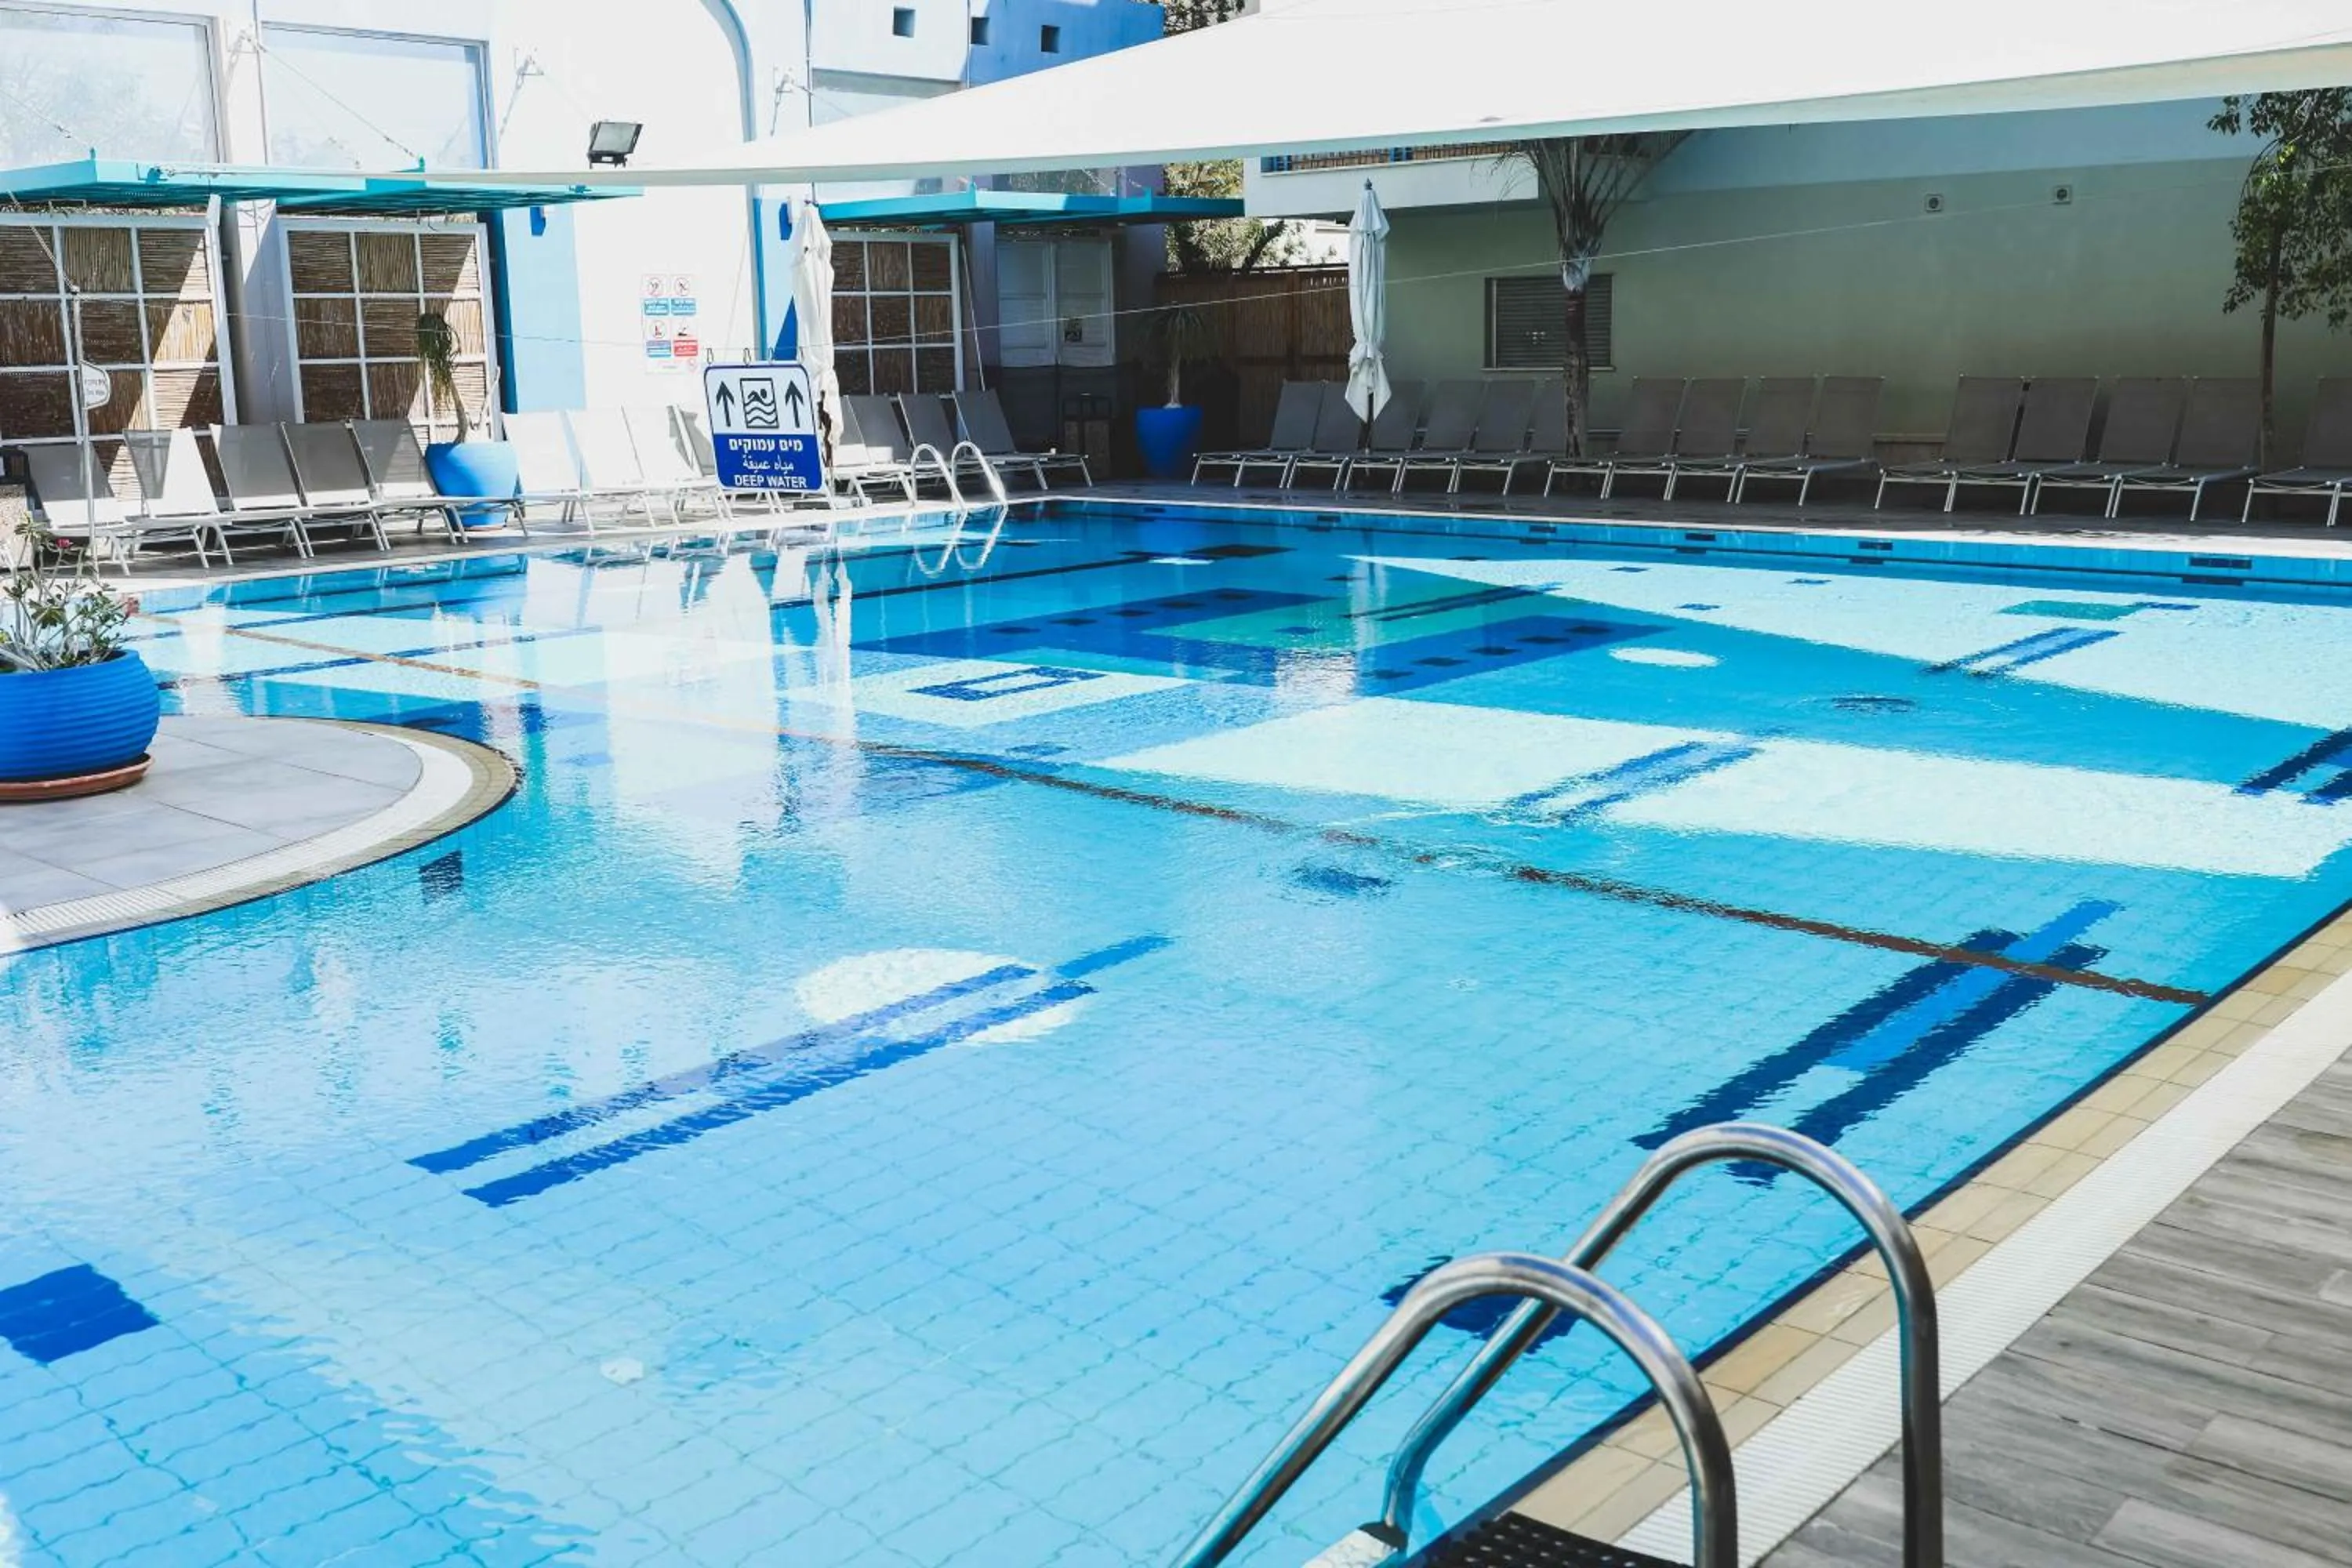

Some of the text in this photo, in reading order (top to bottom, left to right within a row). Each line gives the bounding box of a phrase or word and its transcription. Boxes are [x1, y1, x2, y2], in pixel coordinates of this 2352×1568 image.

[728, 438, 804, 453] מים עמוקים
[742, 454, 794, 474] مياه عميقة
[734, 474, 808, 488] DEEP WATER
